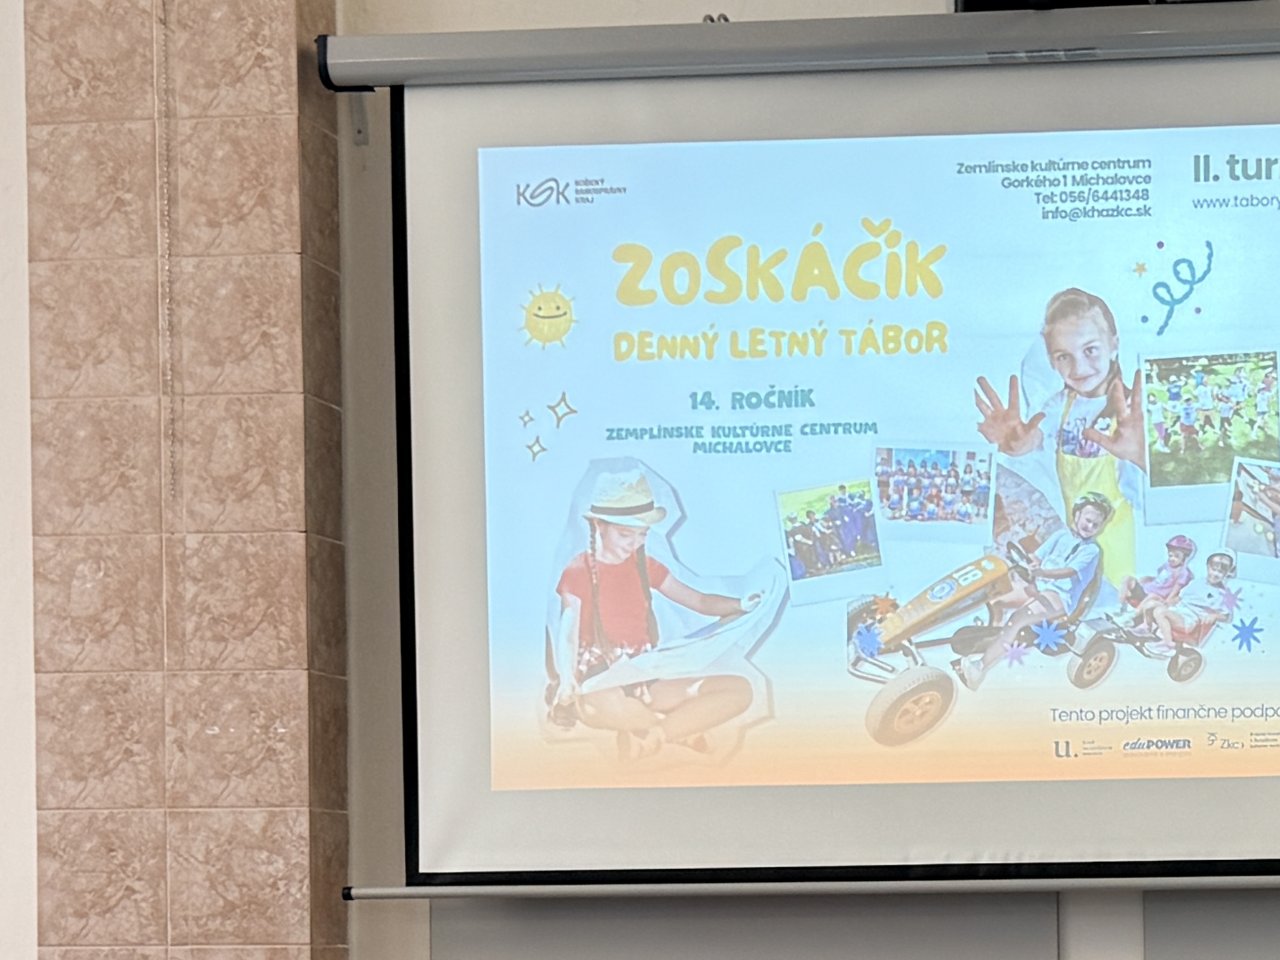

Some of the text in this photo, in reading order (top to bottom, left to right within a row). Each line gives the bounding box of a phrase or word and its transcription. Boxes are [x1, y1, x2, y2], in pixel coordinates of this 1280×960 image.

[956, 158, 1151, 174] Zemlínske kultúrne centrum
[1001, 174, 1061, 189] Gorkého
[1072, 173, 1151, 187] Michalovce
[1059, 187, 1150, 205] 056/6441348
[1041, 205, 1151, 222] info@khazkc.sk
[613, 318, 949, 362] DENNÝ LETNÝ TÁBOR
[689, 384, 816, 411] 14. ROČNÍK
[605, 421, 878, 441] ZEMPLÍNSKE KULTÚRNE CENTRUM
[692, 440, 792, 454] MICHALOVCE
[1050, 707, 1095, 722] Tento
[1099, 705, 1153, 725] projekt
[1156, 703, 1228, 720] finančne
[1123, 738, 1192, 750] eduPOWER
